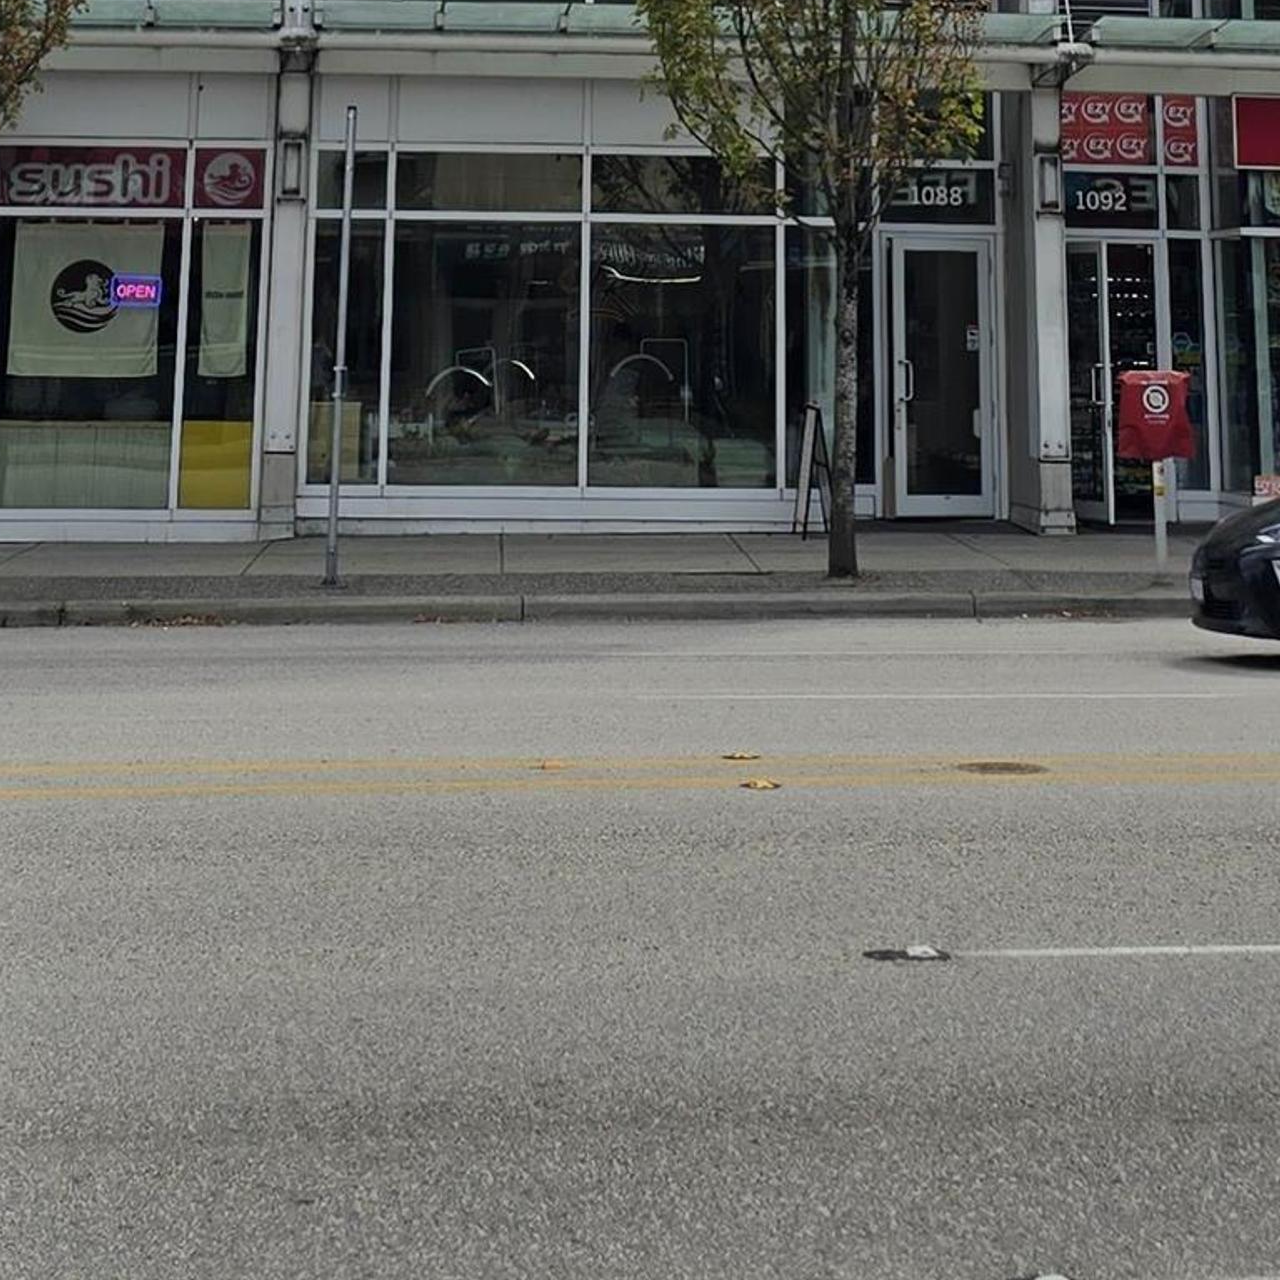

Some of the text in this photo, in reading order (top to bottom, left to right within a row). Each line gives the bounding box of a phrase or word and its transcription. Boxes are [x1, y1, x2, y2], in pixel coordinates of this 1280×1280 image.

[1086, 102, 1113, 115] EZY
[1119, 102, 1146, 115] EZY
[1167, 105, 1194, 118] EZY
[1089, 138, 1115, 151] EZY
[1121, 138, 1148, 151] EZY
[1169, 141, 1196, 154] EZY
[10, 154, 170, 203] sushi
[909, 185, 963, 208] 1088
[1075, 190, 1127, 211] 1092
[116, 283, 157, 299] OPEN
